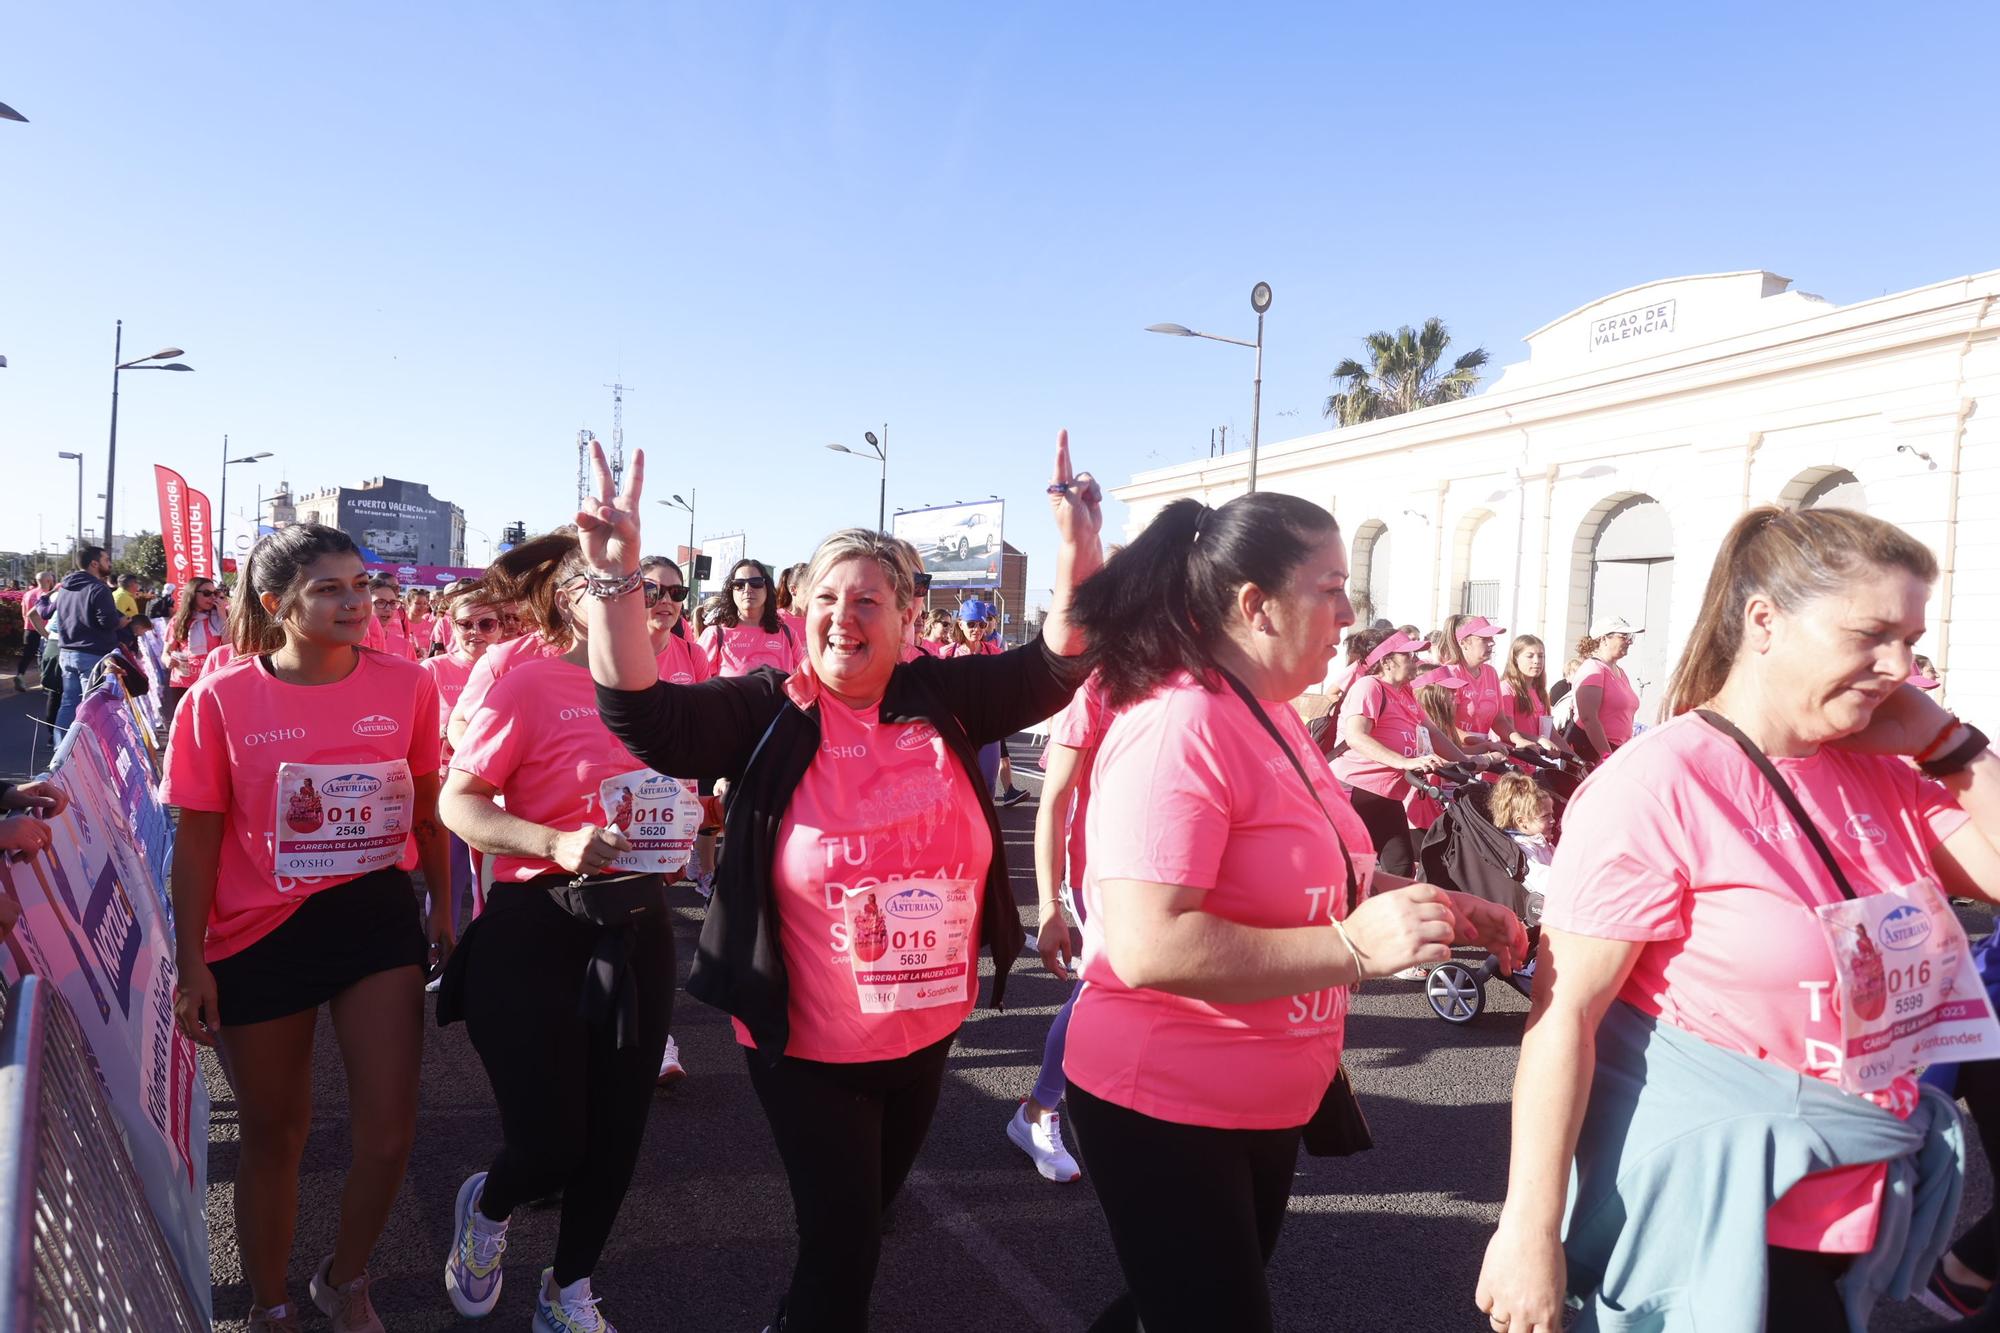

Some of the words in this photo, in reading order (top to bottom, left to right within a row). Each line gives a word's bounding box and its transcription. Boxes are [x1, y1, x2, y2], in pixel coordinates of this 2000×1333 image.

[1598, 314, 1638, 333] GRAO
[1646, 306, 1667, 321] DE
[1595, 319, 1668, 346] VALENCIA
[357, 499, 387, 510] PUERTO
[560, 707, 599, 721] OYSH
[245, 727, 306, 746] OYSHO
[822, 739, 867, 760] OSHO
[326, 782, 378, 793] ASTURIANA
[639, 786, 678, 796] ASTURIANA
[327, 806, 372, 822] 016
[634, 808, 674, 823] 016
[336, 826, 365, 836] 2549
[640, 826, 666, 836] 5620
[820, 835, 867, 868] TU
[290, 859, 334, 869] OYSHO
[890, 900, 939, 913] ASTURIANA
[892, 930, 937, 949] 016
[900, 953, 927, 966] 5630
[899, 973, 909, 981] DE
[910, 972, 921, 980] LA
[921, 970, 944, 979] MUJER
[1888, 960, 1931, 994] 016
[927, 985, 959, 998] Santander
[1895, 993, 1923, 1015] 5599
